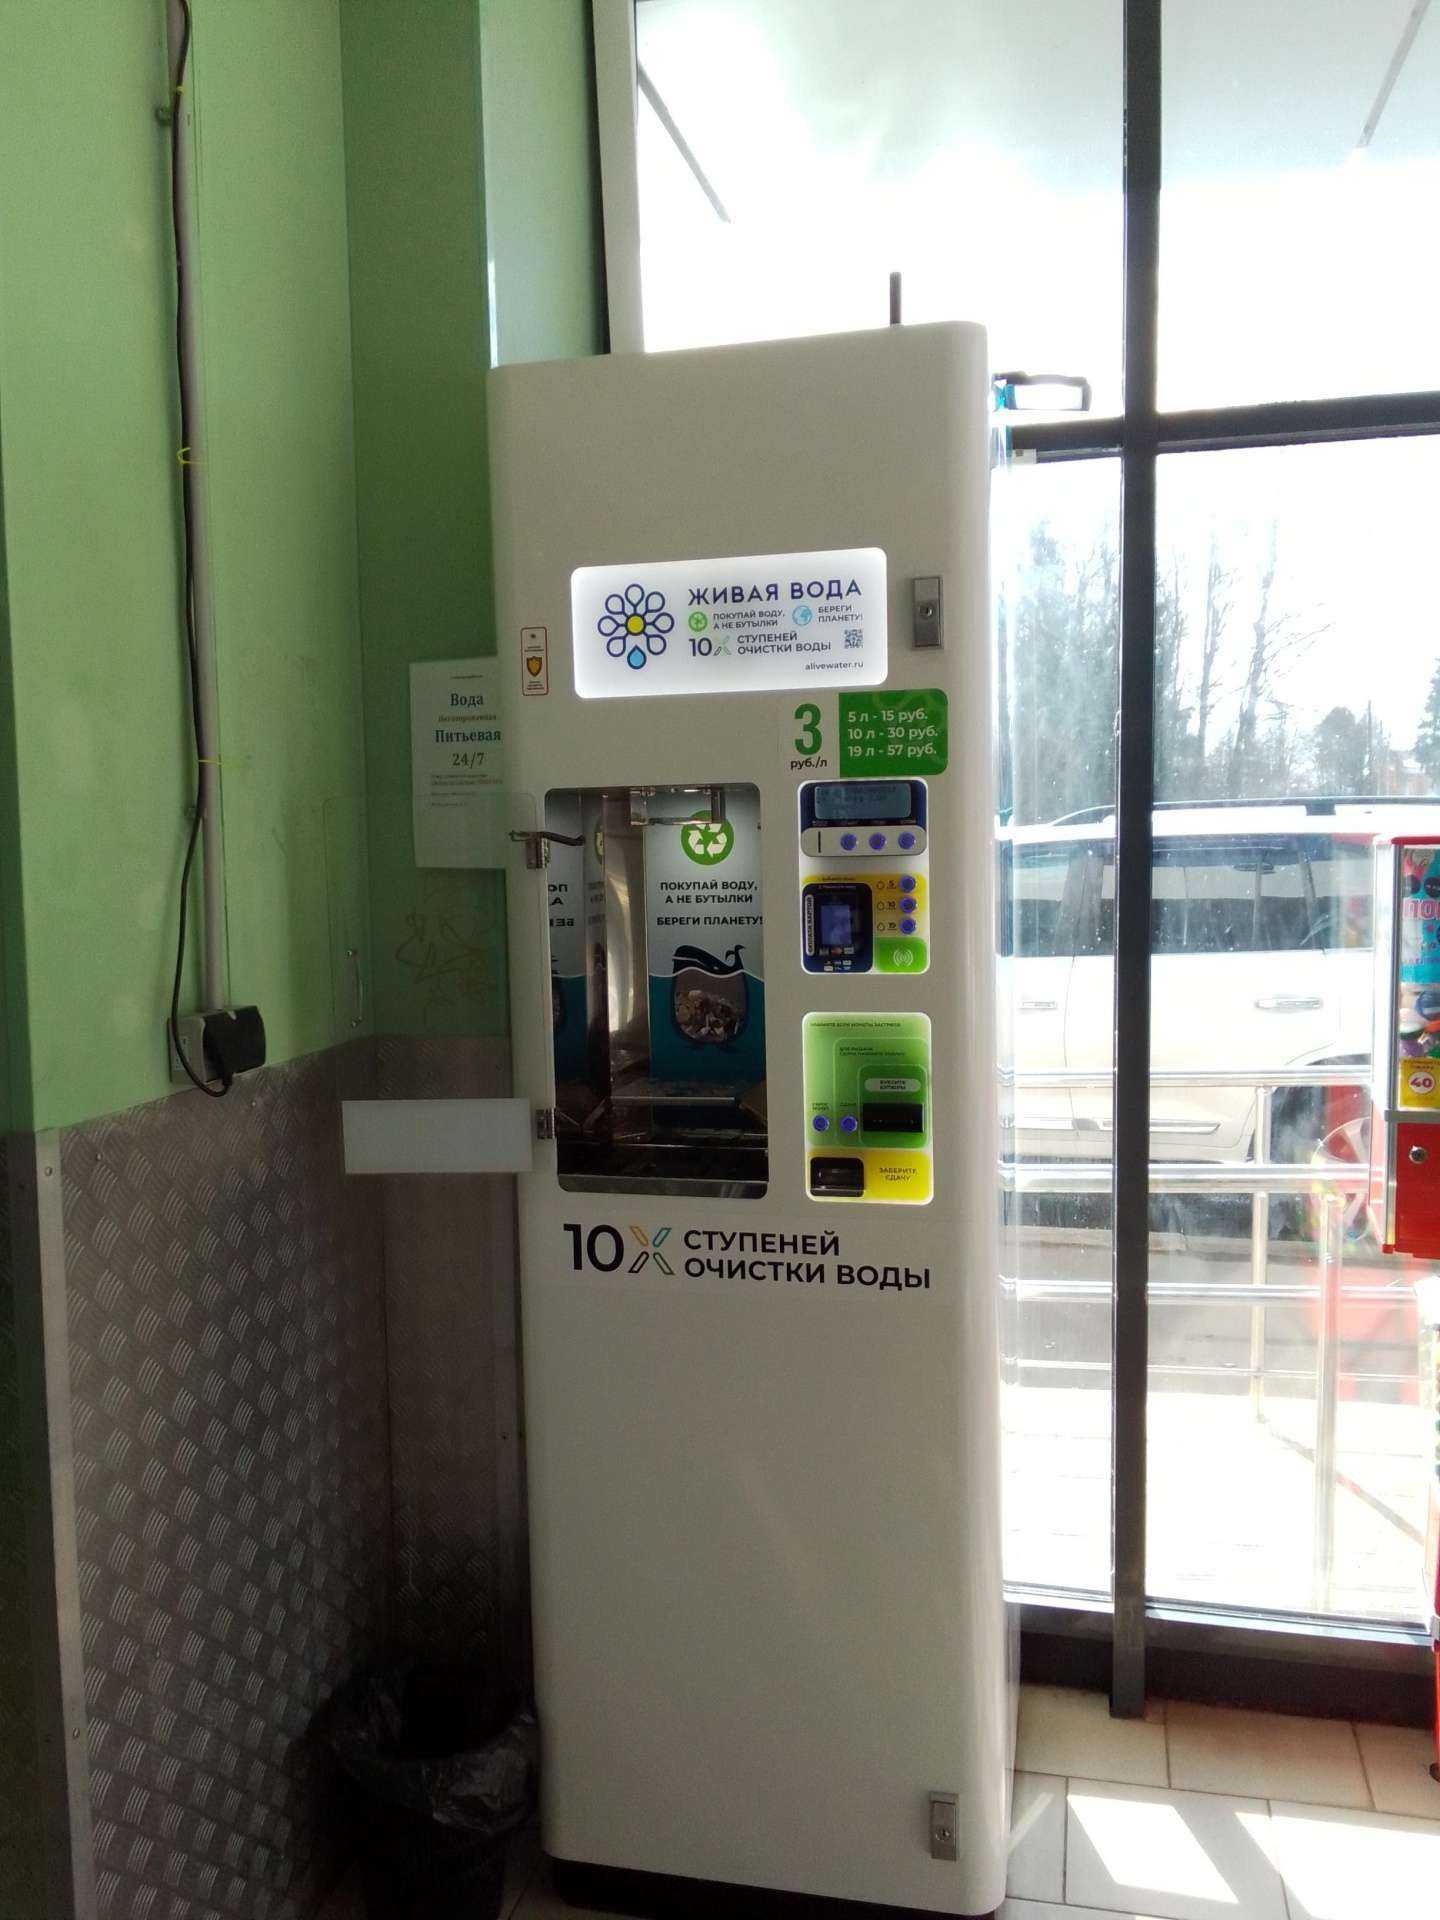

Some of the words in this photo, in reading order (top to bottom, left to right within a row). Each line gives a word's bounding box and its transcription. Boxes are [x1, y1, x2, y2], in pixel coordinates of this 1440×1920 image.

[688, 583, 779, 606] ЖИВАЯ
[790, 579, 862, 601] ВОДА
[713, 609, 756, 621] ПОКУПАЙ
[758, 609, 785, 619] ВОДУ,
[818, 604, 852, 614] БЕРЕГИ
[713, 623, 720, 631] А
[721, 621, 735, 630] НЕ
[736, 619, 779, 629] БУТЫЛКИ
[818, 614, 863, 623] ПЛАНЕТУ!
[737, 630, 798, 644] СТУПЕНЕЙ
[737, 643, 792, 655] ОЧИСТКИ
[795, 641, 832, 653] ВОДЫ
[805, 660, 864, 671] alivewater.ru
[450, 692, 484, 708] Вода
[848, 711, 857, 722] 5
[859, 713, 869, 722] л
[881, 710, 895, 721] 15
[898, 708, 928, 723] руб.
[434, 728, 502, 744] Питьевая
[794, 703, 823, 756] 3
[848, 728, 862, 740] 10
[865, 730, 875, 739] л
[887, 727, 905, 738] 30
[909, 725, 938, 741] руб.
[848, 746, 862, 757] 19
[865, 747, 874, 757] л
[887, 744, 903, 756] 57
[907, 743, 937, 758] руб.
[452, 751, 485, 769] 24/7
[790, 756, 828, 771] руб./л
[660, 880, 718, 891] ПОКУПАЙ
[722, 880, 758, 892] ВОДУ,
[665, 895, 674, 904] А
[677, 894, 691, 904] НЕ
[695, 894, 753, 904] БУТЫЛКИ
[657, 916, 700, 926] БЕРЕГИ
[703, 916, 763, 926] ПЛАНЕТУ!
[1410, 1077, 1432, 1089] 40
[683, 1229, 840, 1257] СТУПЕНЕЙ
[684, 1257, 825, 1284] ОЧИСТКИ
[837, 1263, 931, 1290] ВОДЫ
